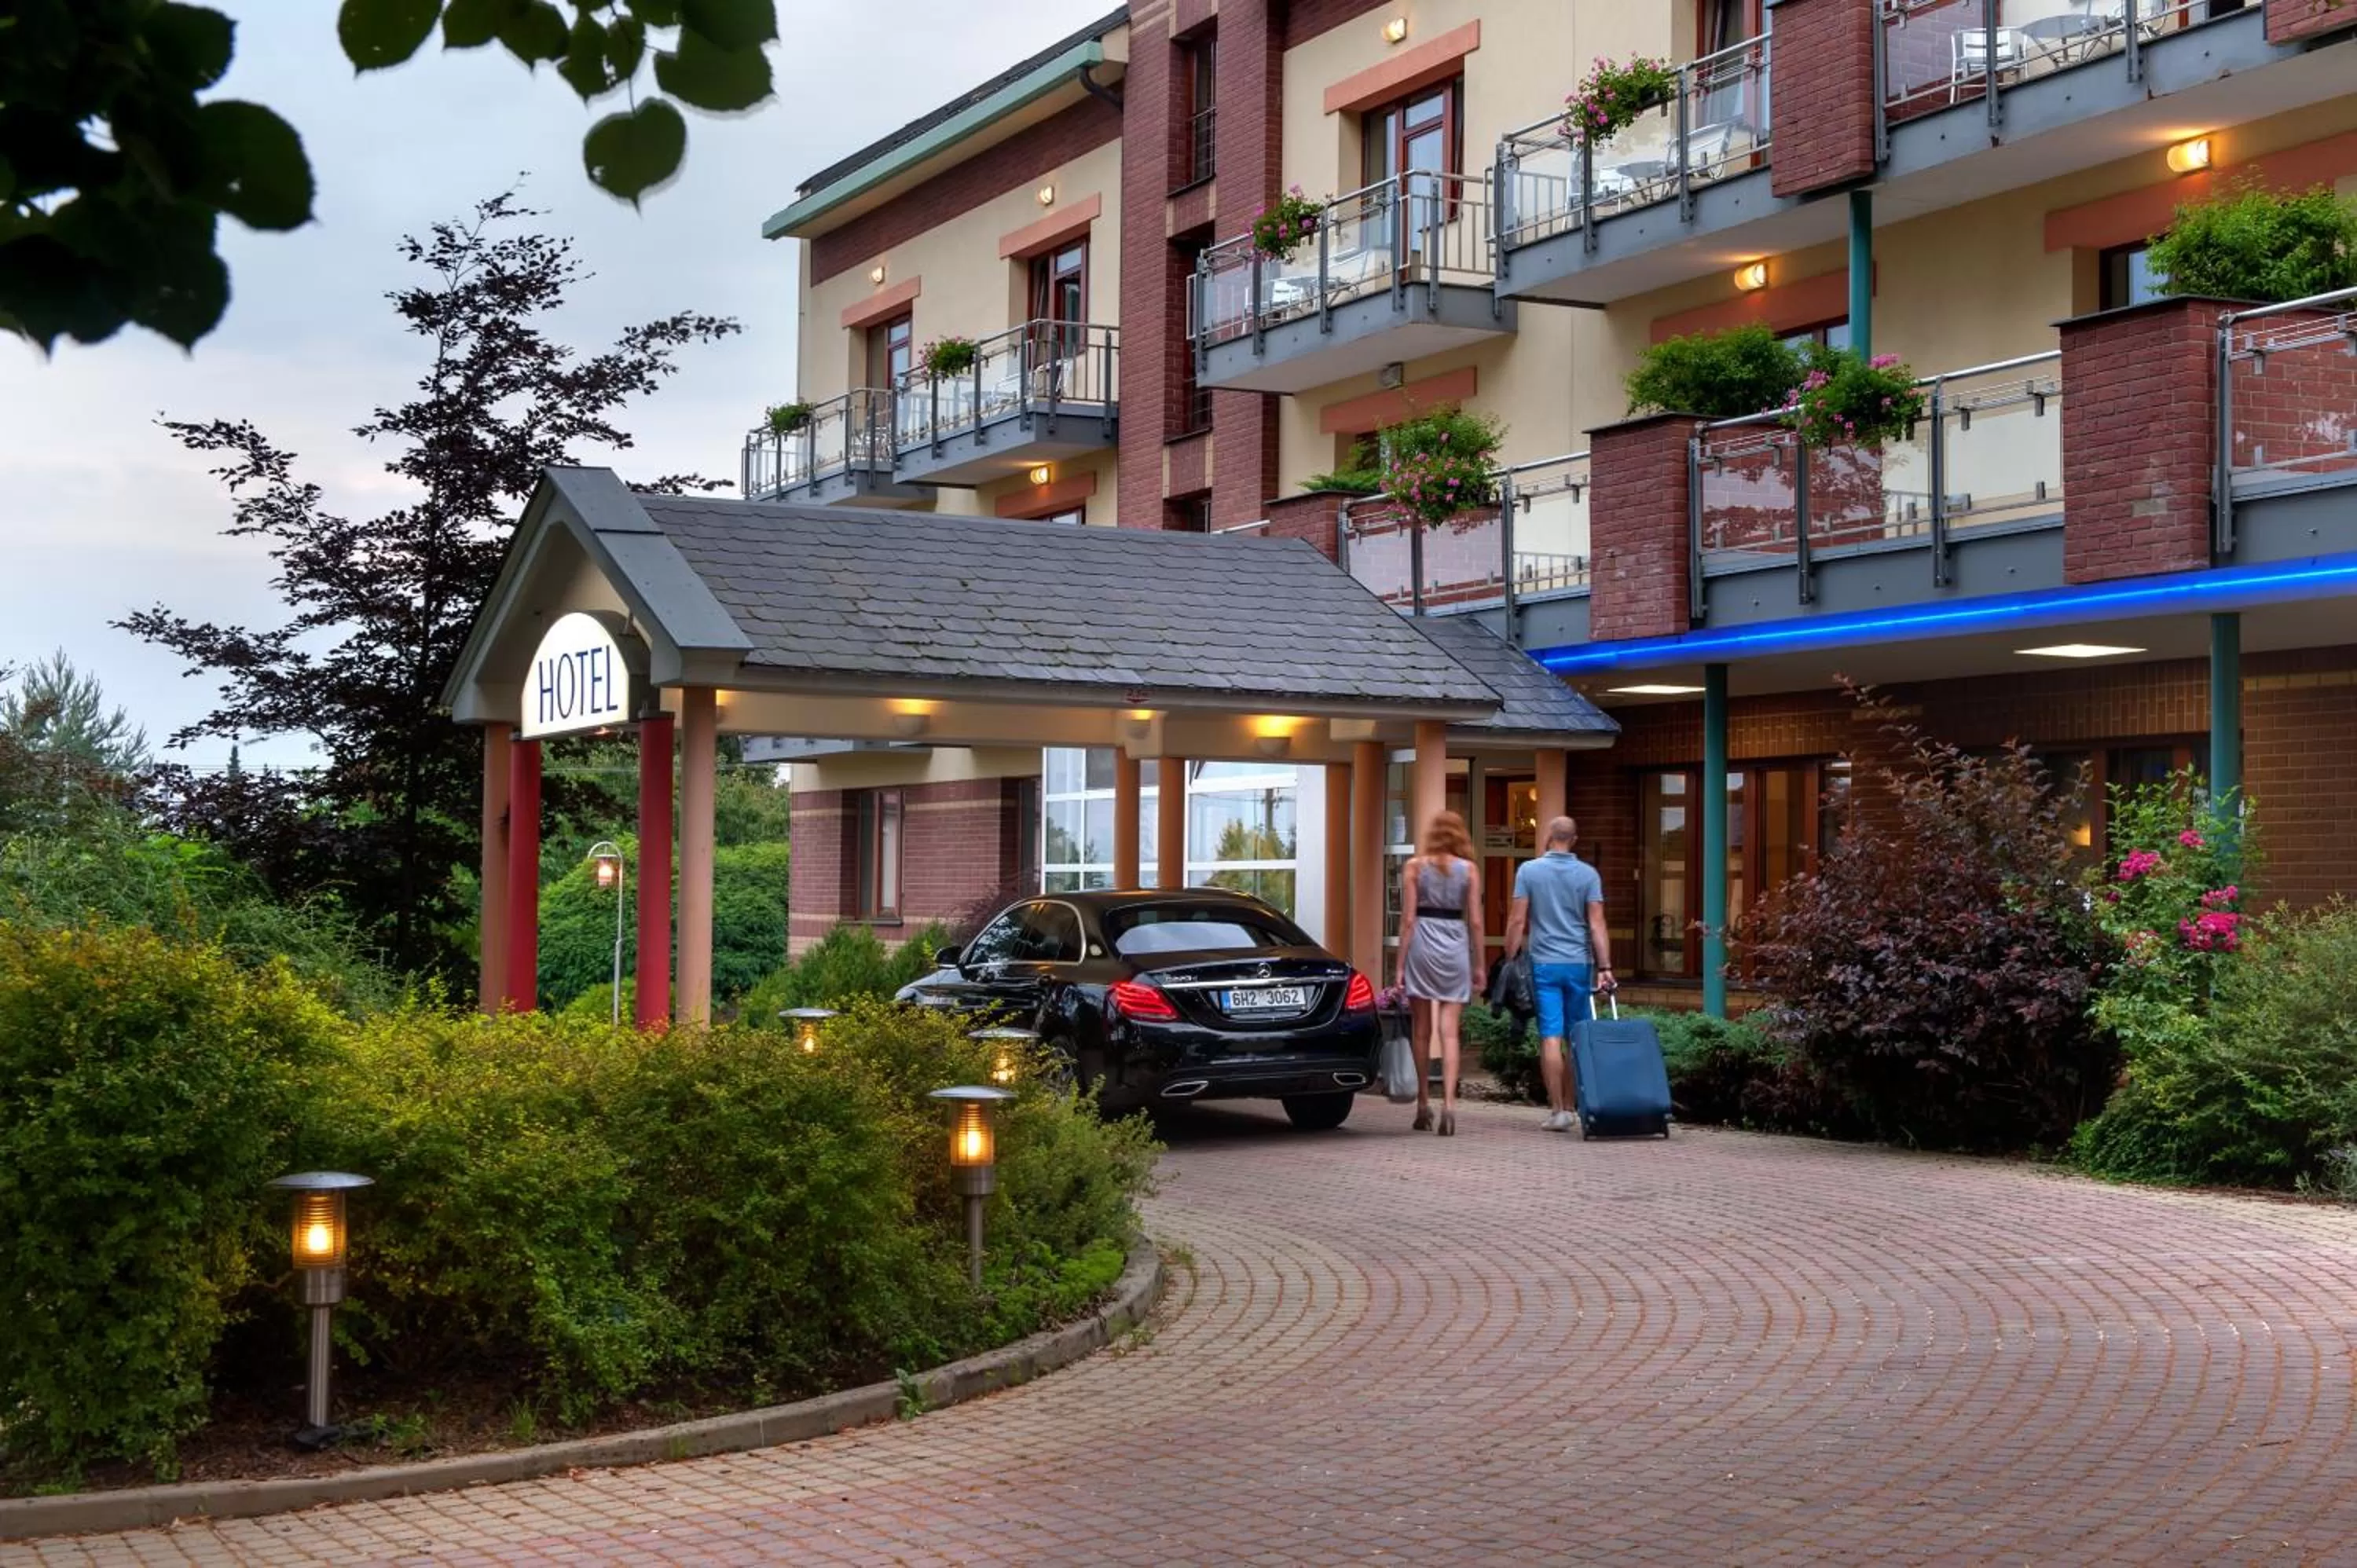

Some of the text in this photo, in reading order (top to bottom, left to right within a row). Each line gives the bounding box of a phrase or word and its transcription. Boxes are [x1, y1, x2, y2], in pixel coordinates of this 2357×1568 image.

[539, 645, 618, 724] HOTEL
[1233, 990, 1299, 1006] 6H2 3062
